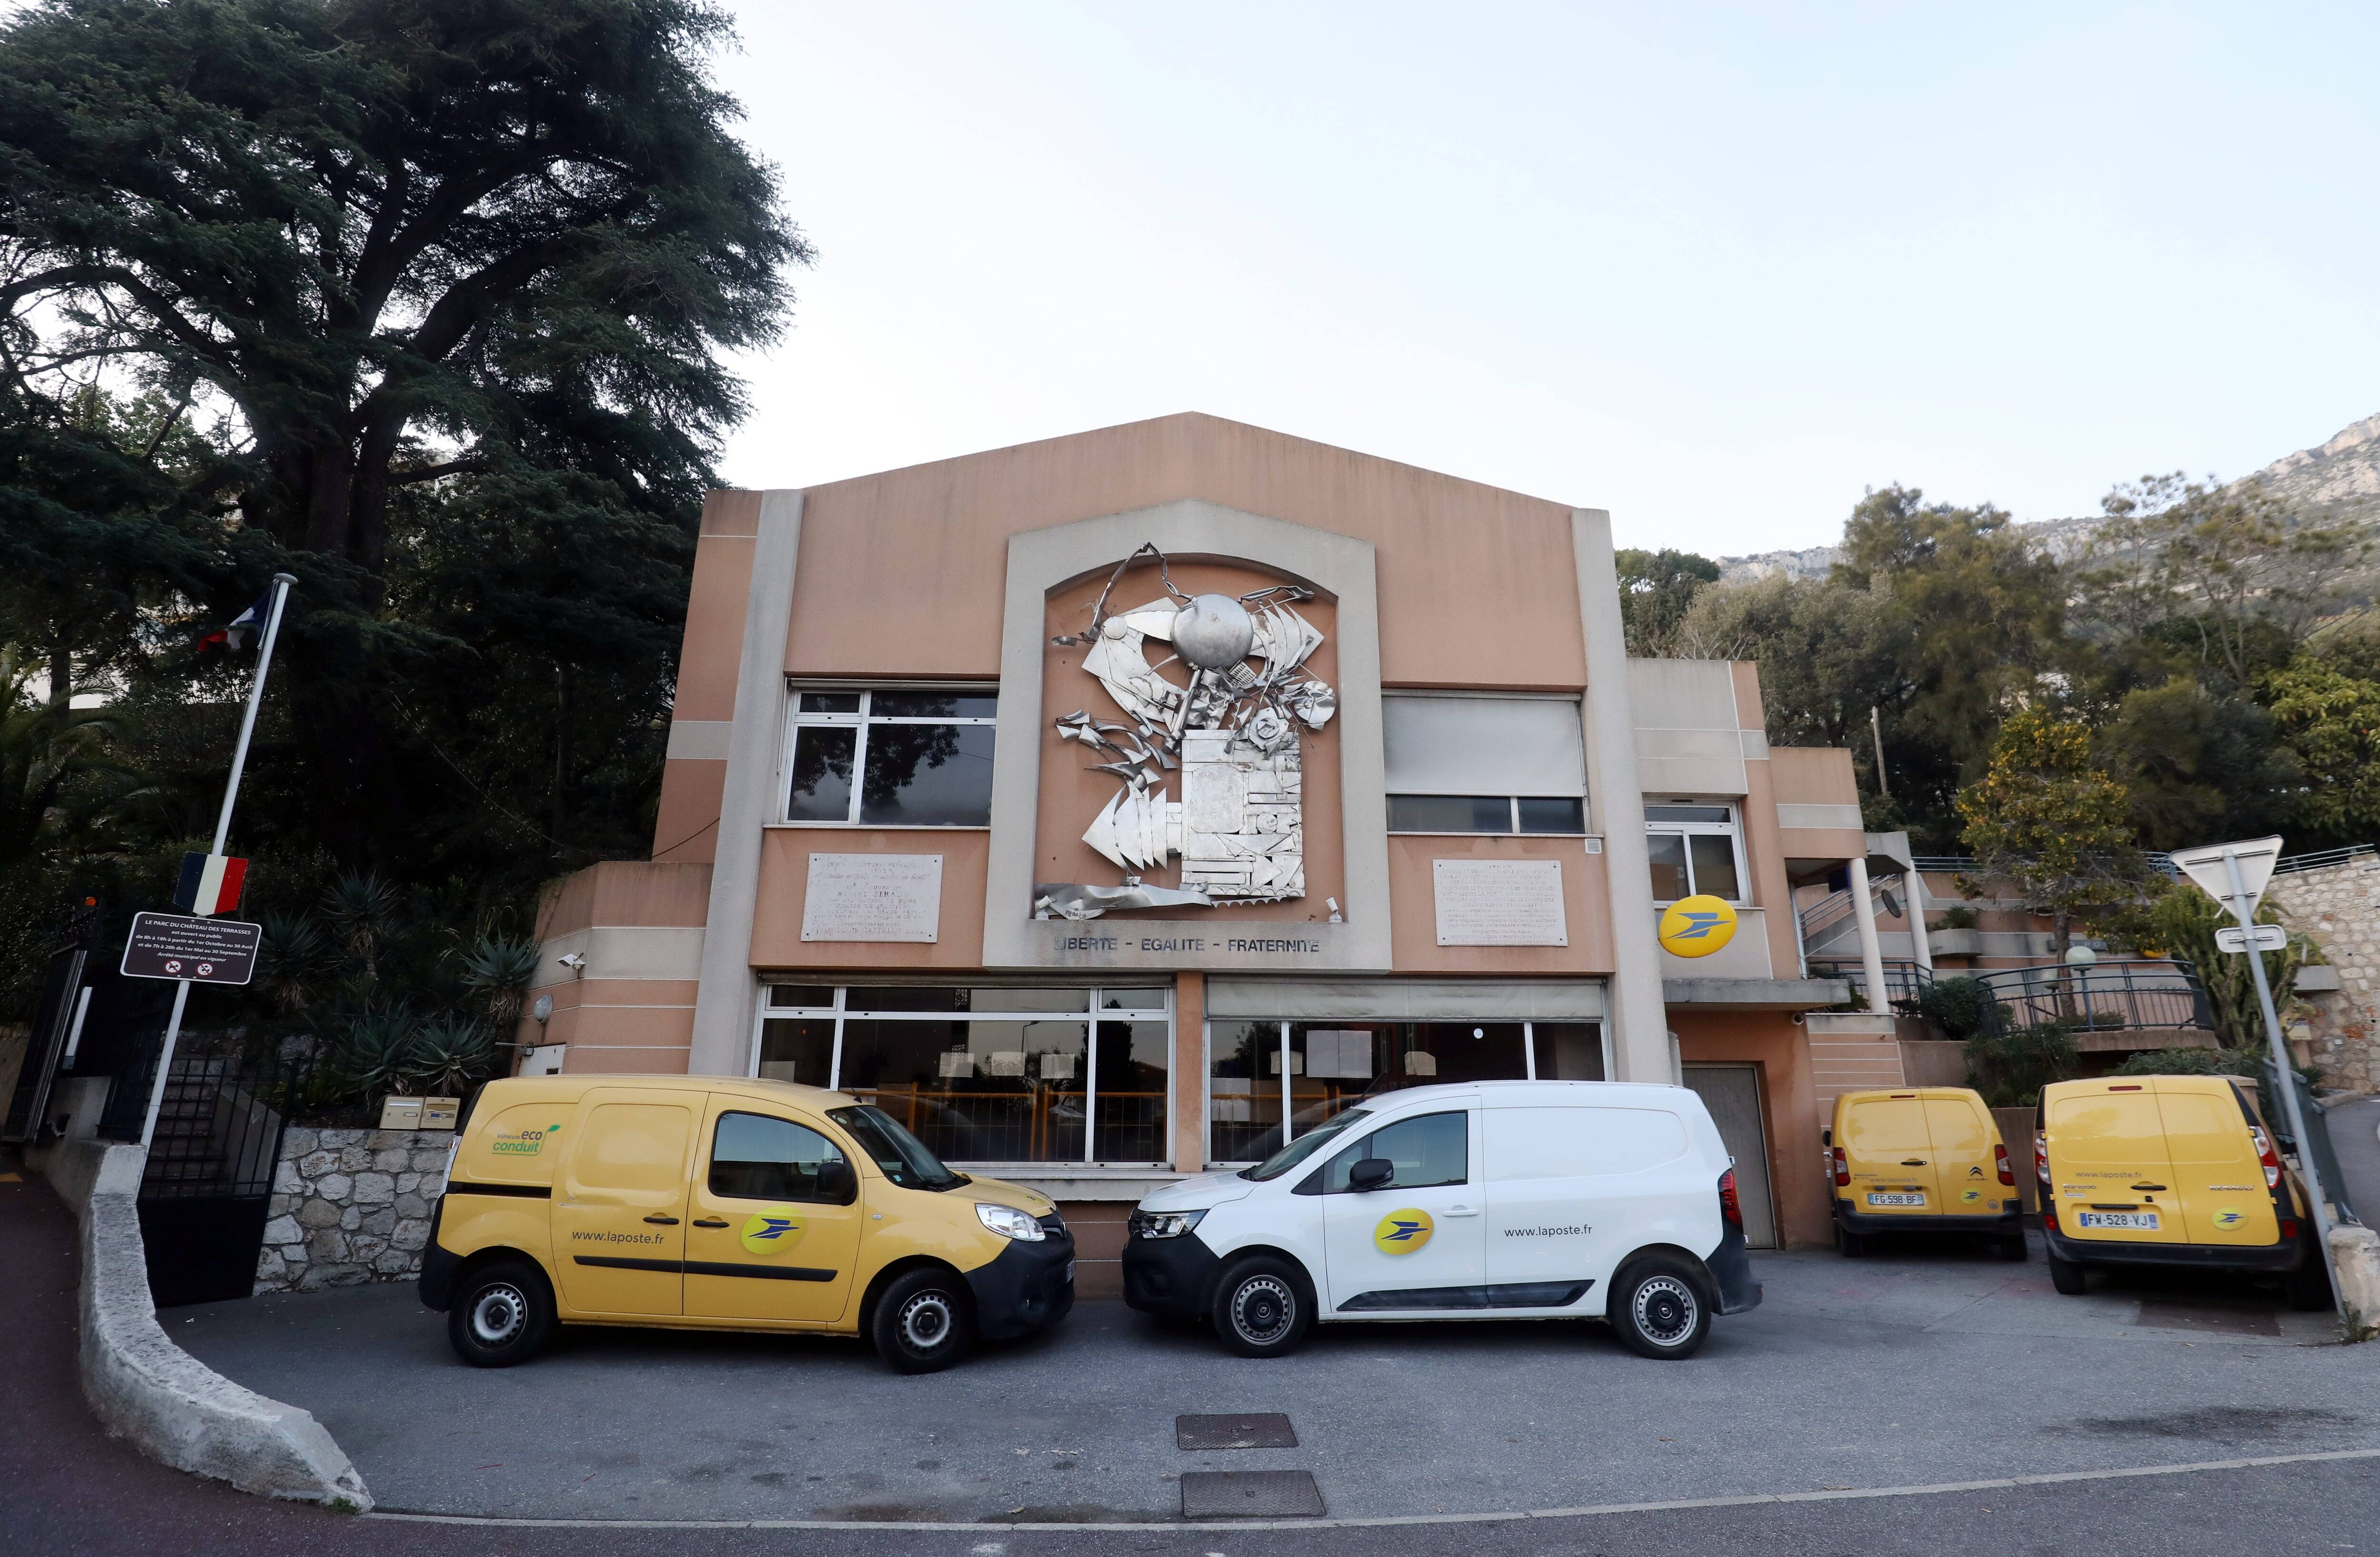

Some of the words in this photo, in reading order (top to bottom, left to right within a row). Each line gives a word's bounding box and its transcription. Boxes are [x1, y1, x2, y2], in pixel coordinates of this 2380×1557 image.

[1054, 937, 1117, 951] LIBERTE
[1142, 938, 1204, 951] EGALITE
[1228, 939, 1319, 952] FRATERNITE
[521, 1131, 543, 1140] eco
[493, 1141, 539, 1152] conduit
[1874, 1195, 1916, 1204] FG-598-BF
[2087, 1214, 2148, 1226] FW-528-VJ
[1504, 1224, 1592, 1238] www.laposte.fr
[572, 1230, 664, 1245] www.laposte.fr
